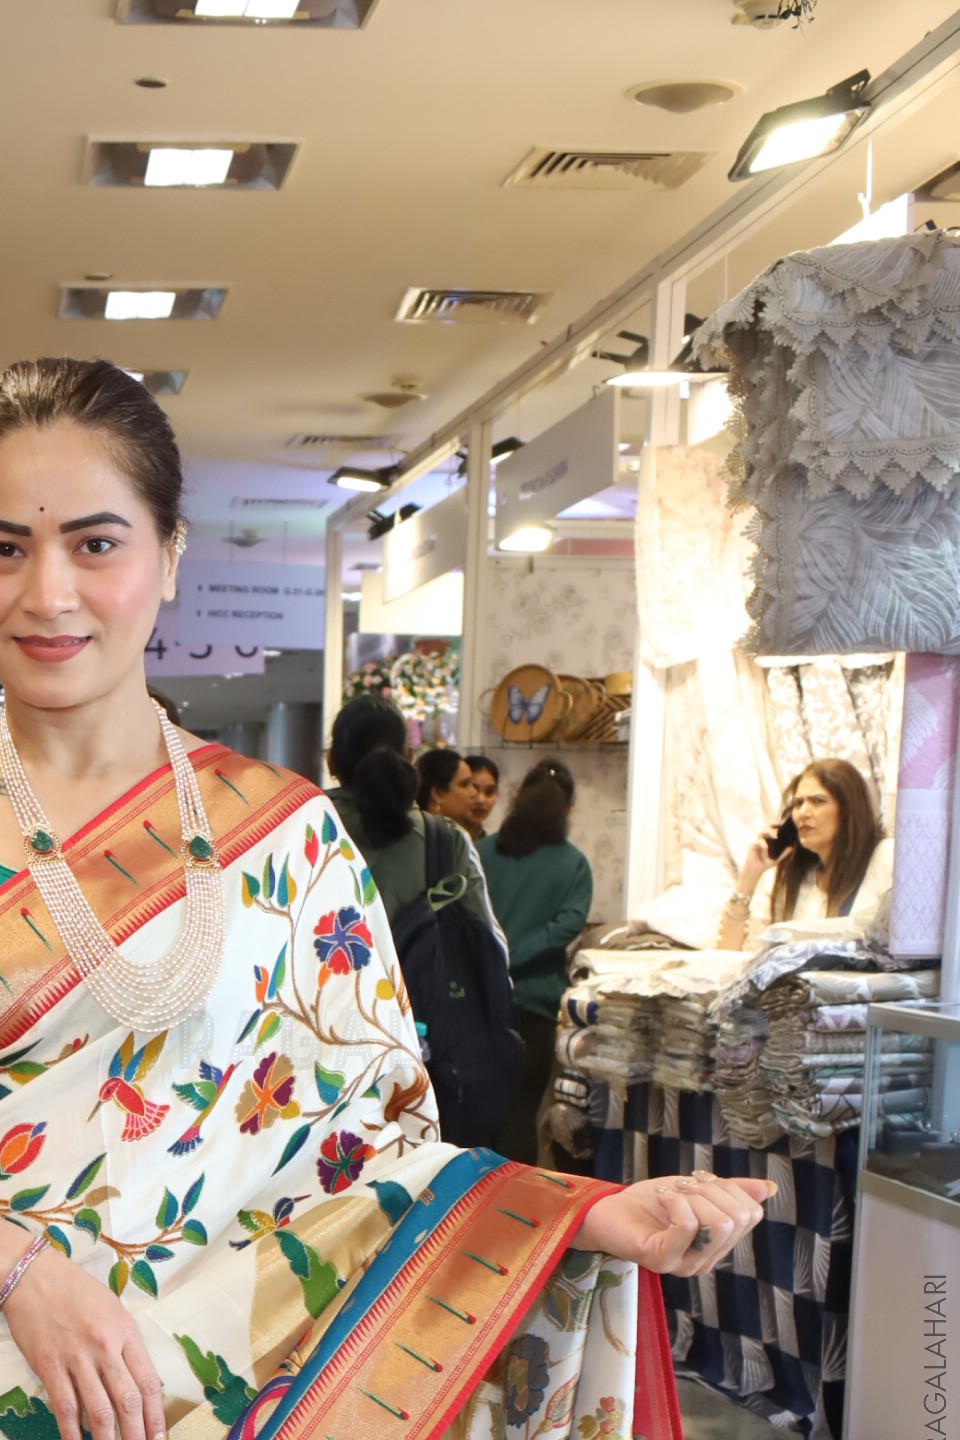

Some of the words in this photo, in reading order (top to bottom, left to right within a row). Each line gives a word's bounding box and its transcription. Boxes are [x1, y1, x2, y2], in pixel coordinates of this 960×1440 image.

[209, 584, 250, 594] MEETING
[252, 585, 279, 595] ROOM
[231, 610, 283, 620] RECEPTION
